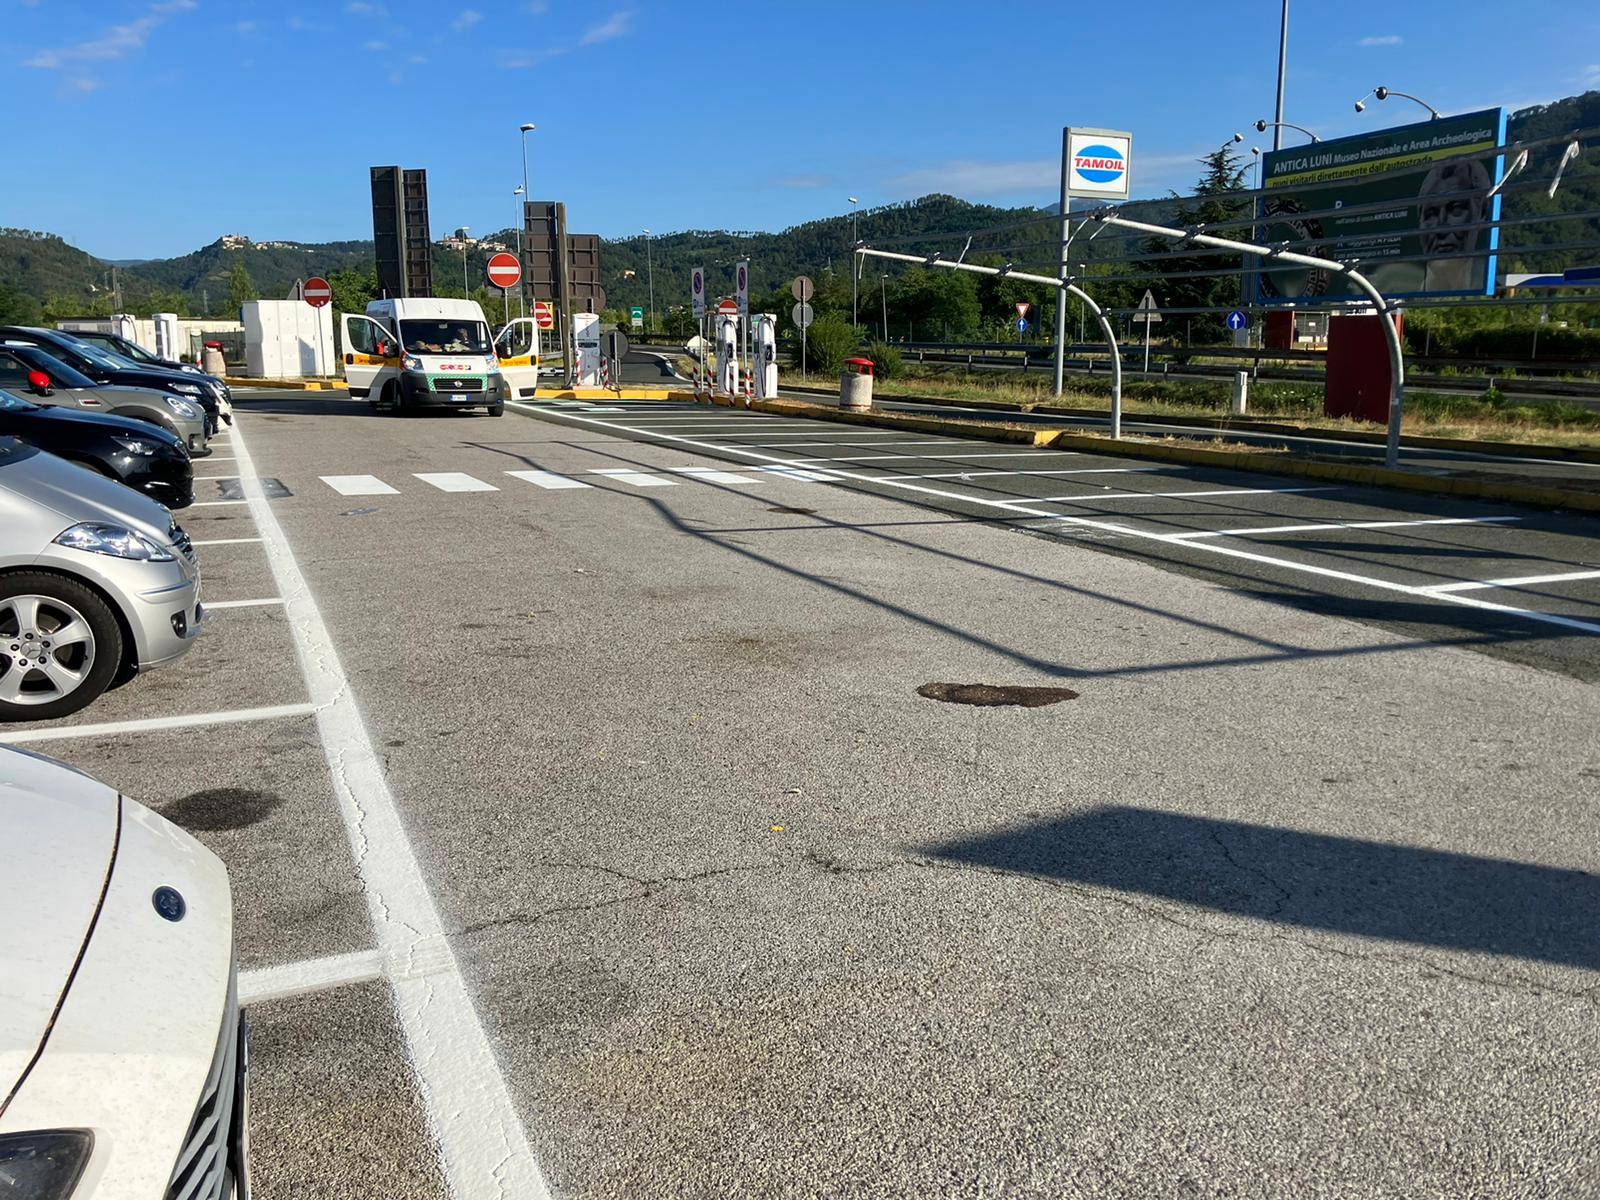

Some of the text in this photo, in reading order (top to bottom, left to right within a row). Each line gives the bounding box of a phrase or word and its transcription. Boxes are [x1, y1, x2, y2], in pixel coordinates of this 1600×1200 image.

[1274, 158, 1308, 174] ANTICA
[1310, 153, 1332, 168] LUNI
[1334, 152, 1359, 163] Museo
[1360, 144, 1400, 159] Nazionale
[1409, 140, 1430, 151] Area
[1431, 129, 1492, 146] Archeologica
[1074, 158, 1124, 170] TAMOIL
[1317, 167, 1367, 181] direttamente
